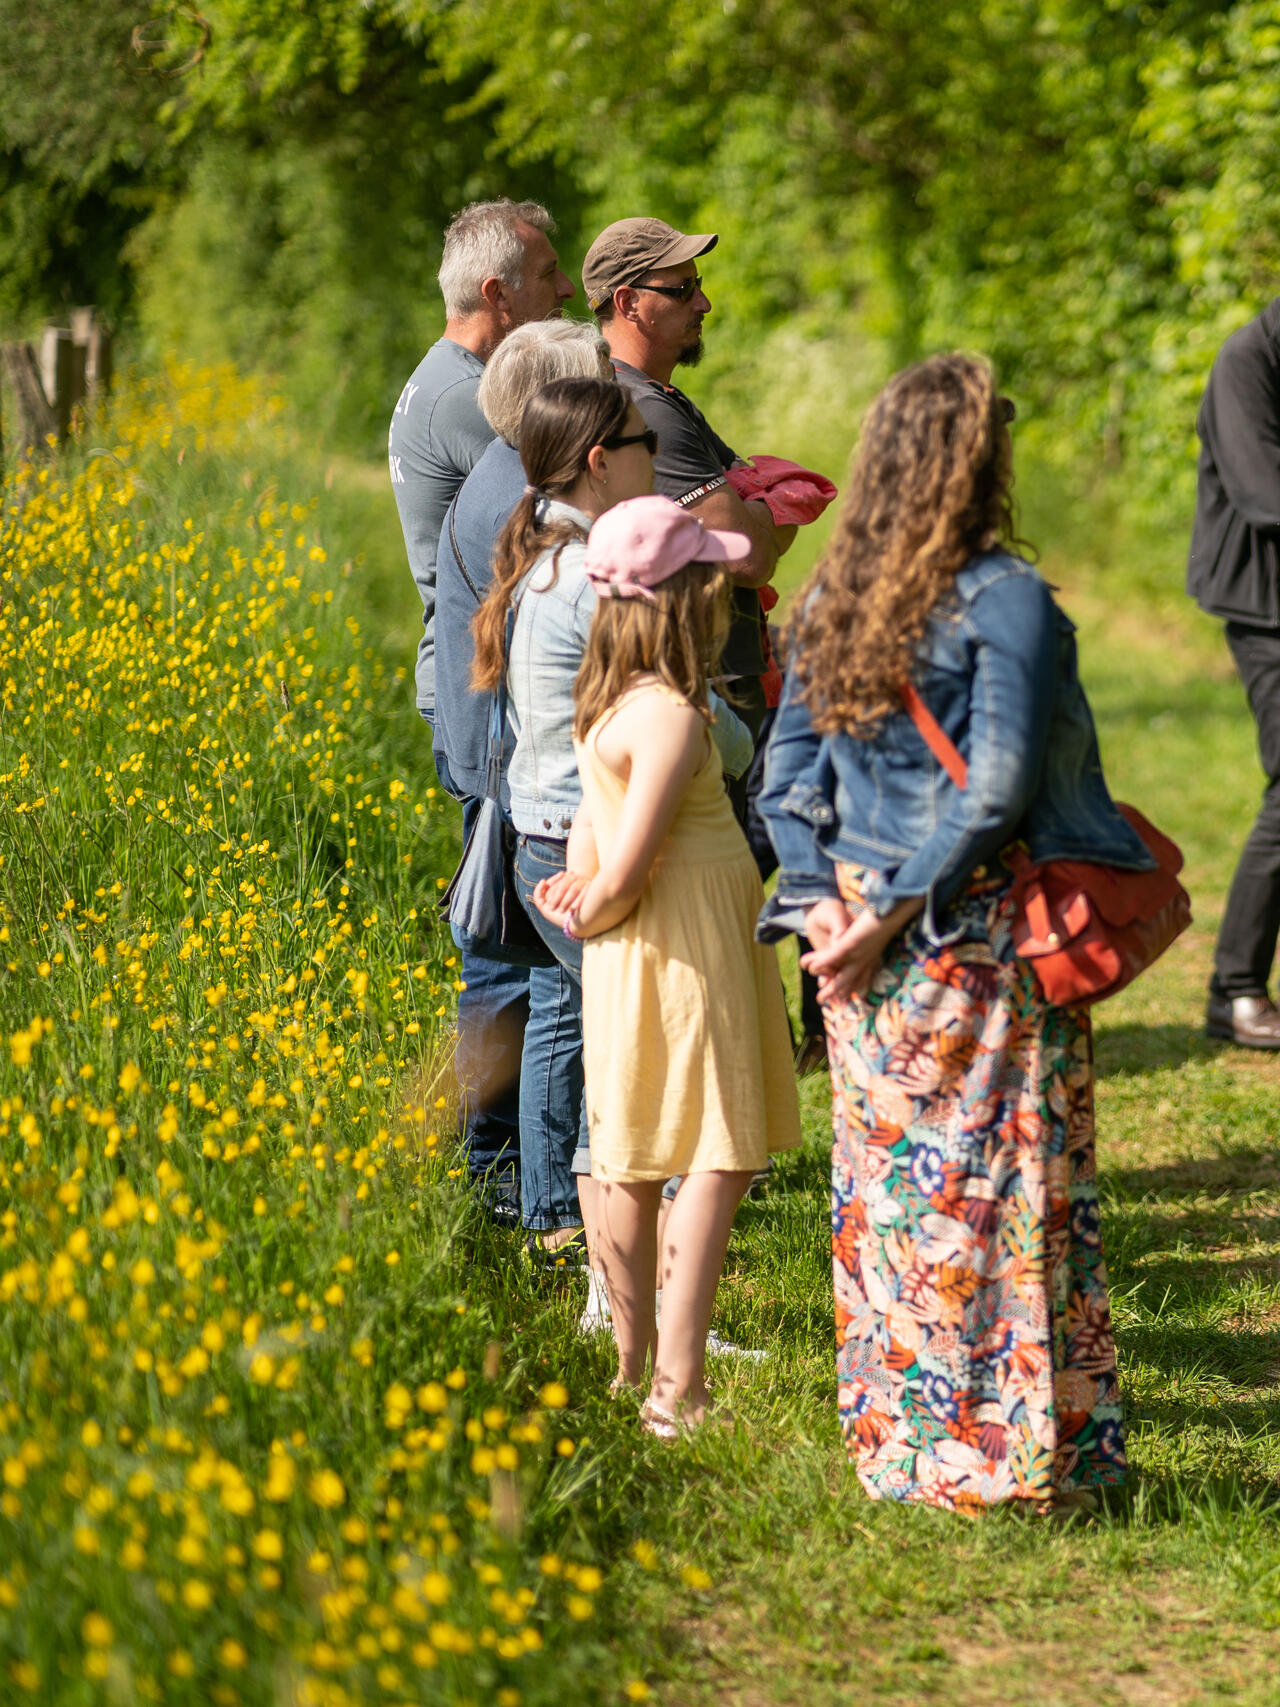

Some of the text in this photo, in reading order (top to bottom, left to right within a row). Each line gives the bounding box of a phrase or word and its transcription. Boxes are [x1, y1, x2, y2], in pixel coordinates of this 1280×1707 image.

[395, 382, 420, 416] EY
[389, 455, 405, 483] RK
[674, 486, 705, 507] XBOW
